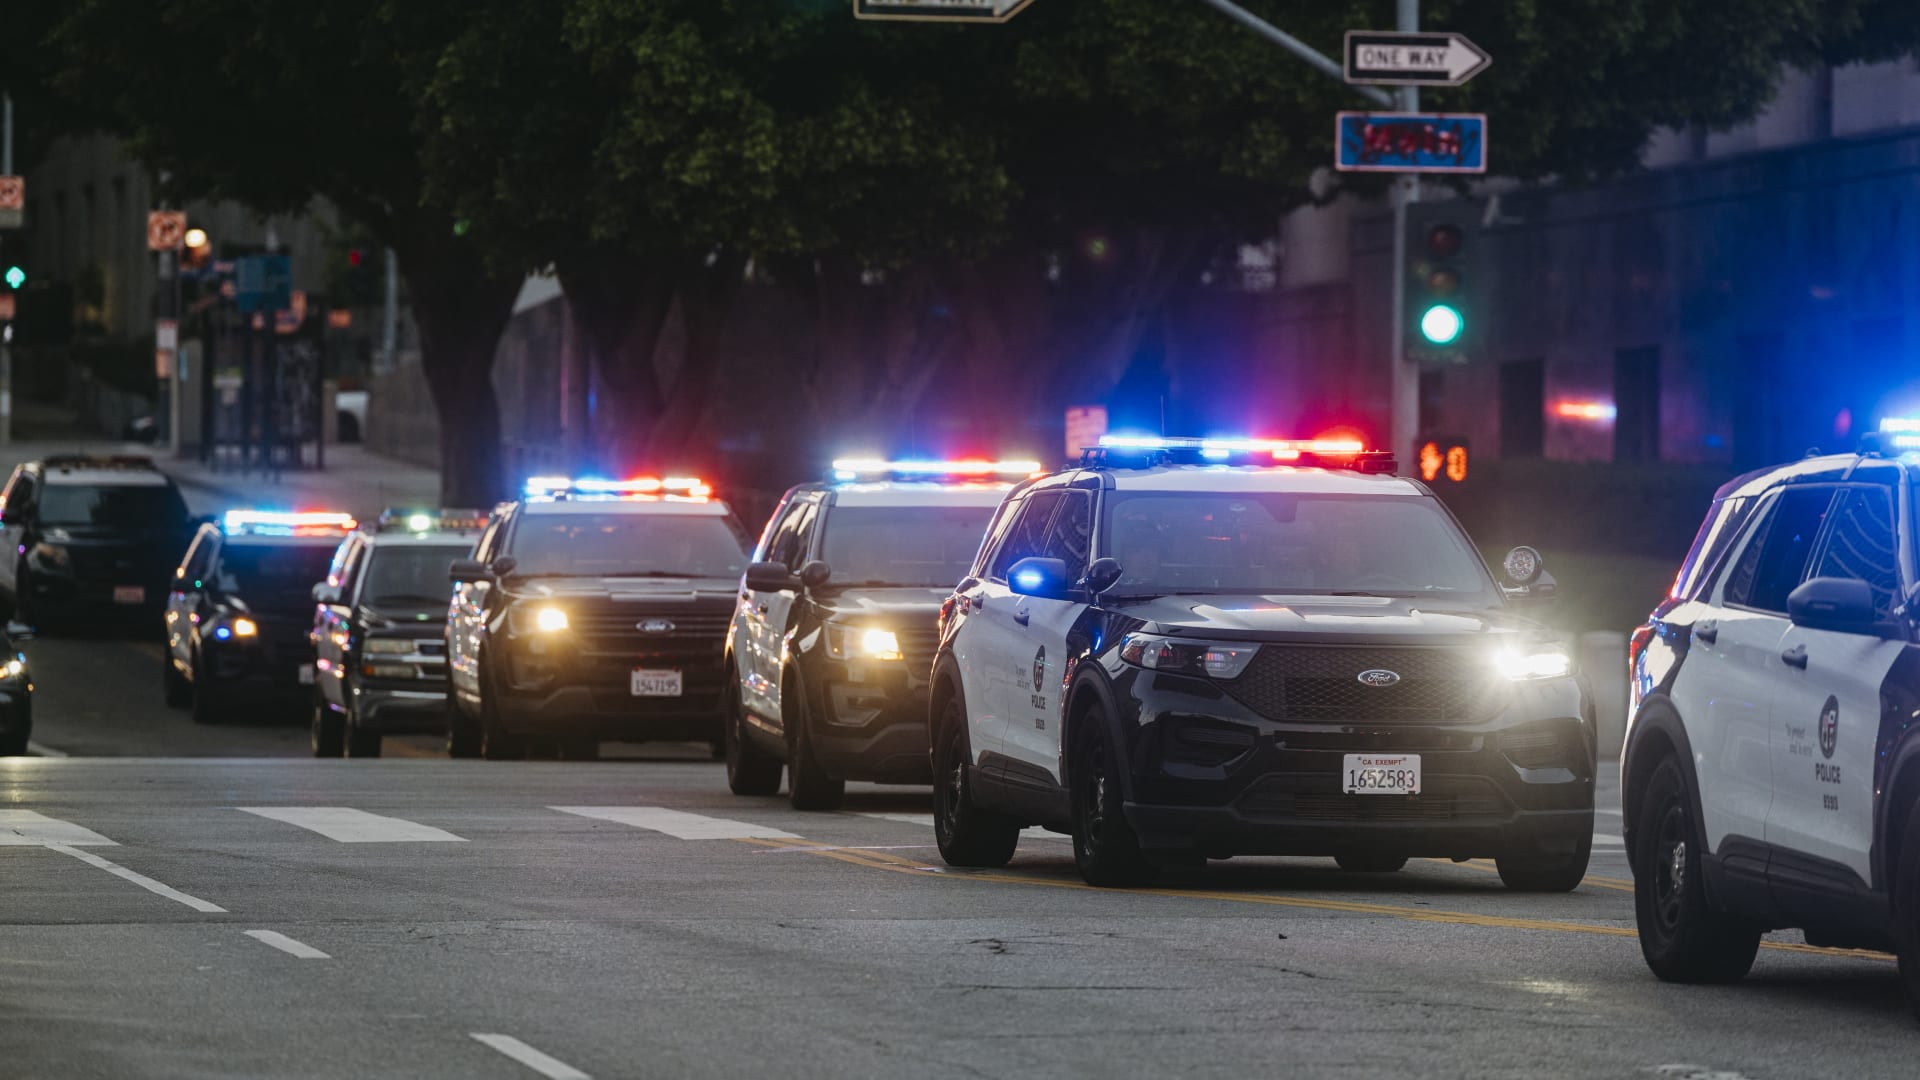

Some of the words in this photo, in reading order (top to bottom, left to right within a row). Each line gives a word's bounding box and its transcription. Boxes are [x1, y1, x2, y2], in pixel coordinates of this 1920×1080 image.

[1363, 50, 1400, 64] ONE
[1408, 51, 1447, 65] WAY
[1031, 694, 1046, 710] POLICE
[1348, 769, 1416, 789] 1652583
[1815, 762, 1841, 784] POLICE
